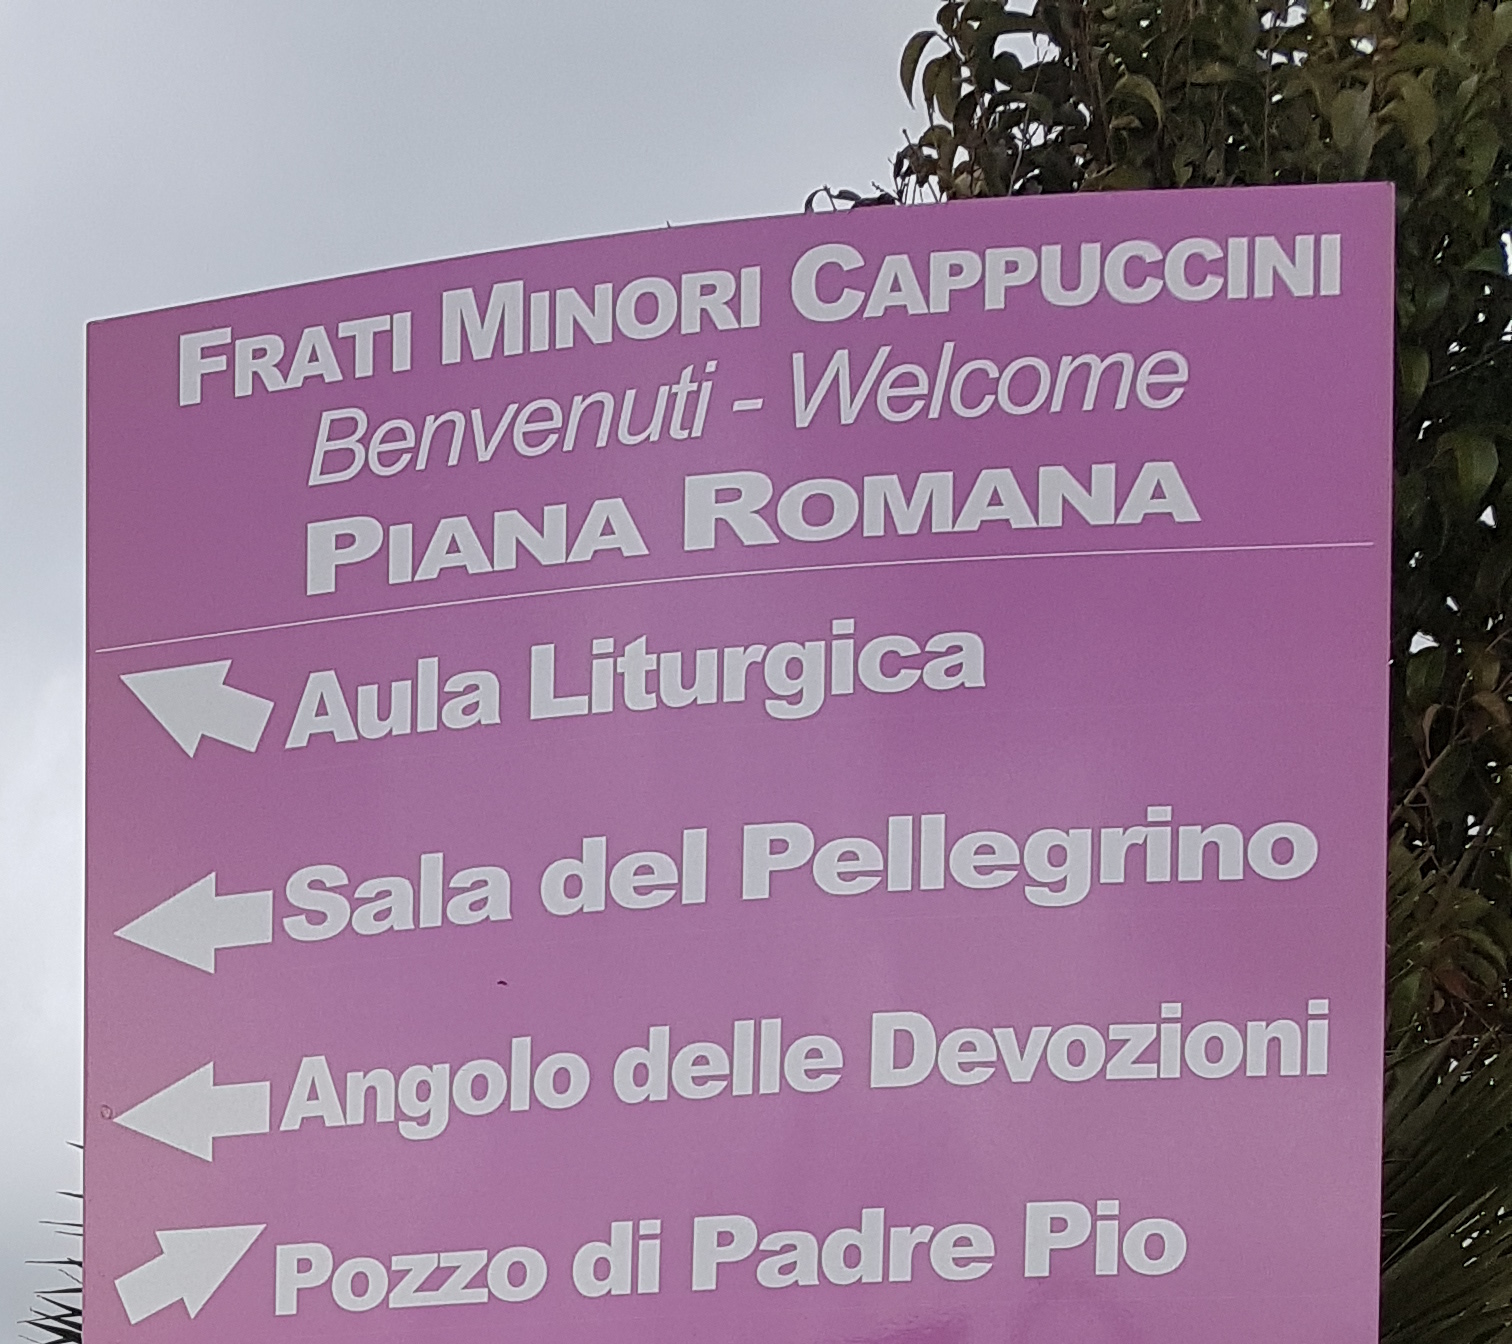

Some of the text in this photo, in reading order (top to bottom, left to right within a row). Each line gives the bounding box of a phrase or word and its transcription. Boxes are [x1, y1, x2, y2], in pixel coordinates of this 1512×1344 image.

[178, 232, 1342, 407] FRATI MINORI CAPPUCCINI
[307, 359, 719, 487] Benvenuti
[791, 340, 1190, 428] Welcome
[305, 460, 1202, 596] PIANA ROMANA
[284, 617, 987, 749] Aula Liturgica
[281, 804, 1320, 942] Sala del Pellegrino
[279, 997, 1330, 1141] Angolo delle Devozioni
[273, 1198, 1189, 1316] Pozzo di Padre Pio
